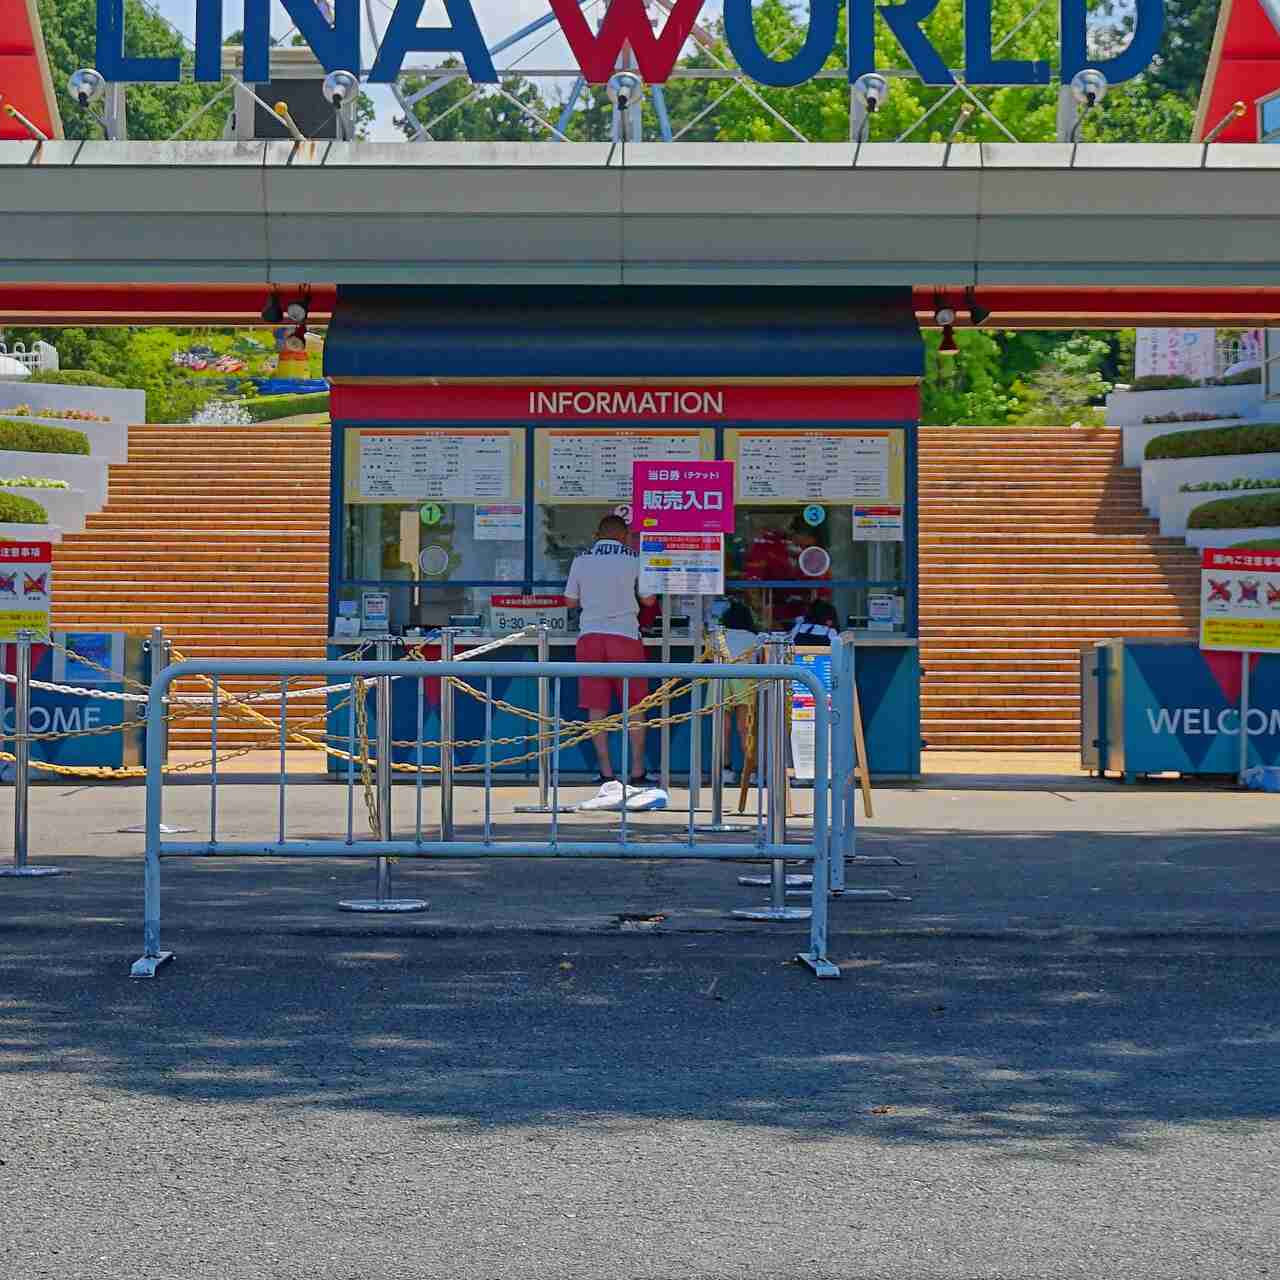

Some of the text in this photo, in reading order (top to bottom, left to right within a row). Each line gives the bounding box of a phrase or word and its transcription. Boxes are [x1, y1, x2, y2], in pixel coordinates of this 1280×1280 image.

[528, 391, 724, 414] INFORMATION
[642, 490, 723, 510] 販売入口
